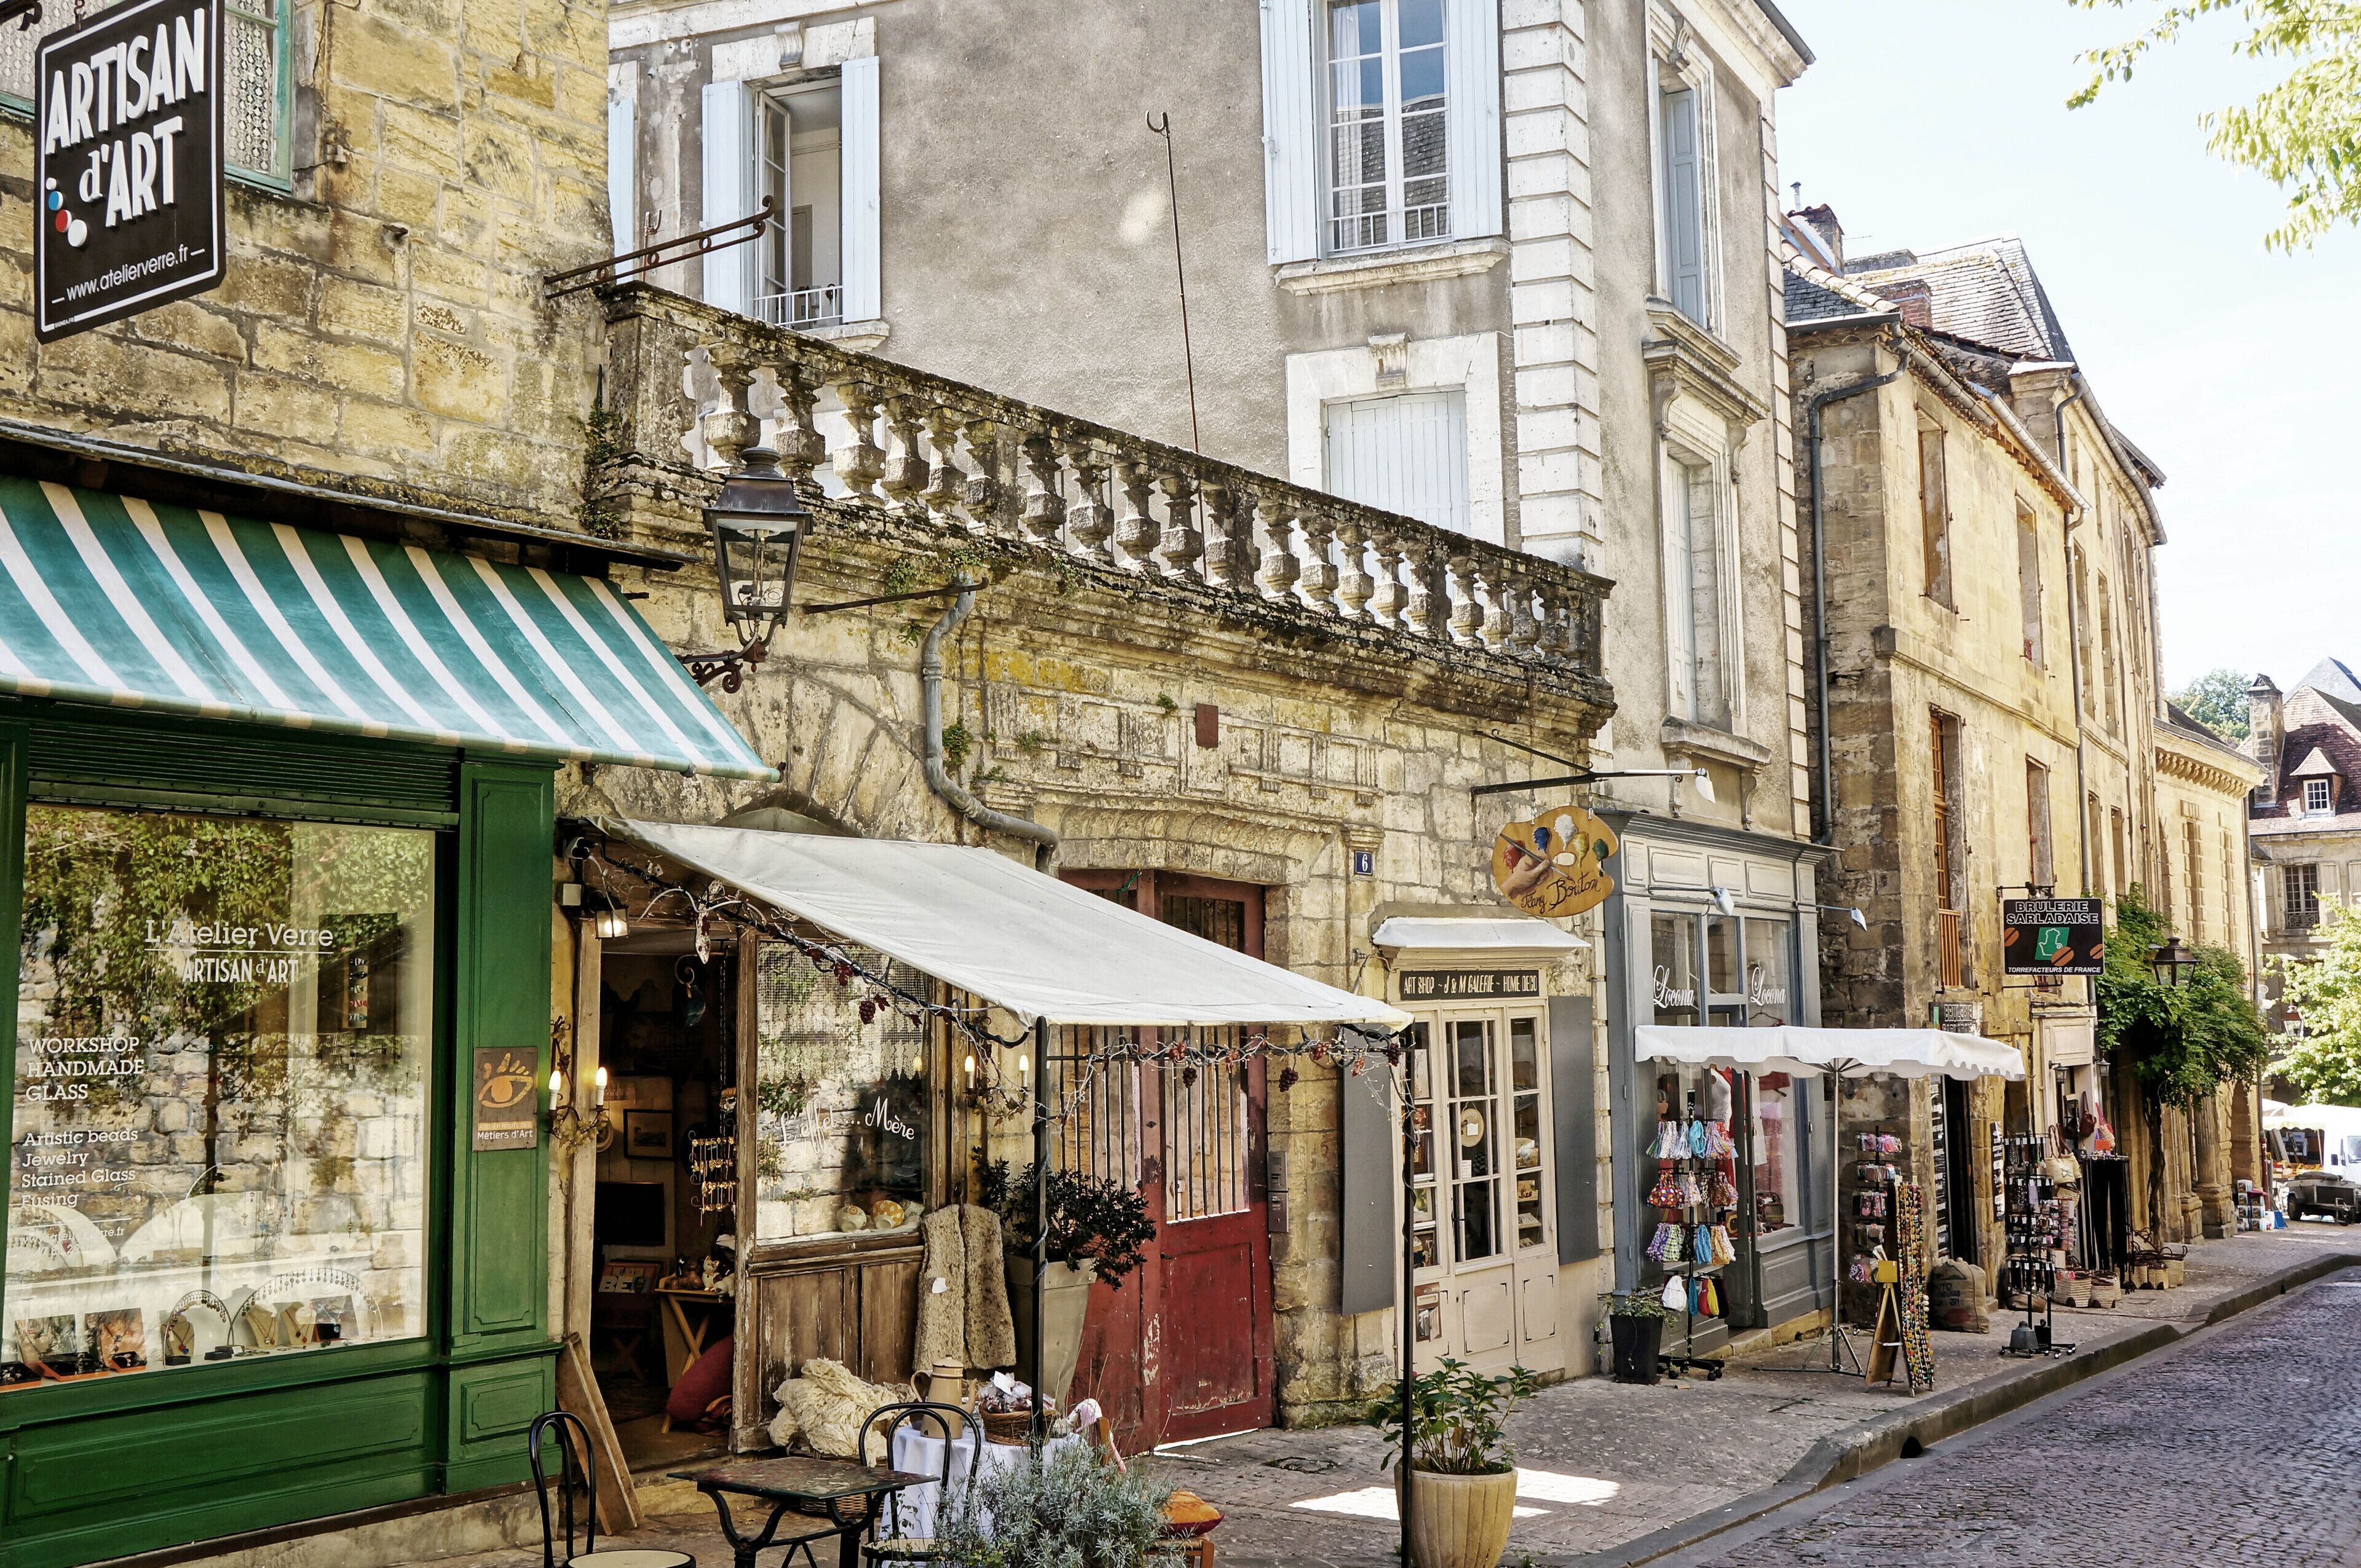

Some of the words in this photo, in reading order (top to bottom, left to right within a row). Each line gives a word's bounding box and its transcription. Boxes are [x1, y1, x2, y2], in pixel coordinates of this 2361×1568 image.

[45, 7, 205, 156] ARTISAN
[79, 116, 183, 227] d'ART
[66, 243, 189, 301] www.atelierverre.fr
[1361, 853, 1369, 872] 6
[2015, 900, 2089, 913] BRULERIE
[2006, 913, 2099, 924] SARLADAISE
[144, 920, 259, 945] L'Atelier
[265, 923, 334, 947] Verre
[182, 958, 253, 983] ARTISAN
[256, 959, 299, 983] d'ART
[1403, 977, 1416, 994] ART
[1418, 976, 1434, 994] SHOP
[1444, 975, 1450, 994] J
[1450, 978, 1457, 994] &
[1458, 975, 1466, 993] M
[1468, 975, 1494, 993] GALERIE
[1503, 975, 1521, 992] HOME
[1522, 975, 1537, 992] DECO
[28, 1036, 140, 1054] WORKSHOP
[26, 1059, 145, 1078] HANDMADE
[26, 1084, 89, 1101] GLASS
[864, 1095, 915, 1140] Mère
[23, 1130, 84, 1147] Artistic
[87, 1128, 138, 1143] beads
[477, 1131, 509, 1140] Métiers
[511, 1130, 533, 1138] d'Art
[22, 1151, 90, 1168] Jewelry
[22, 1170, 87, 1188] Stained
[91, 1169, 136, 1183] Glass
[21, 1192, 79, 1208] Fusing
